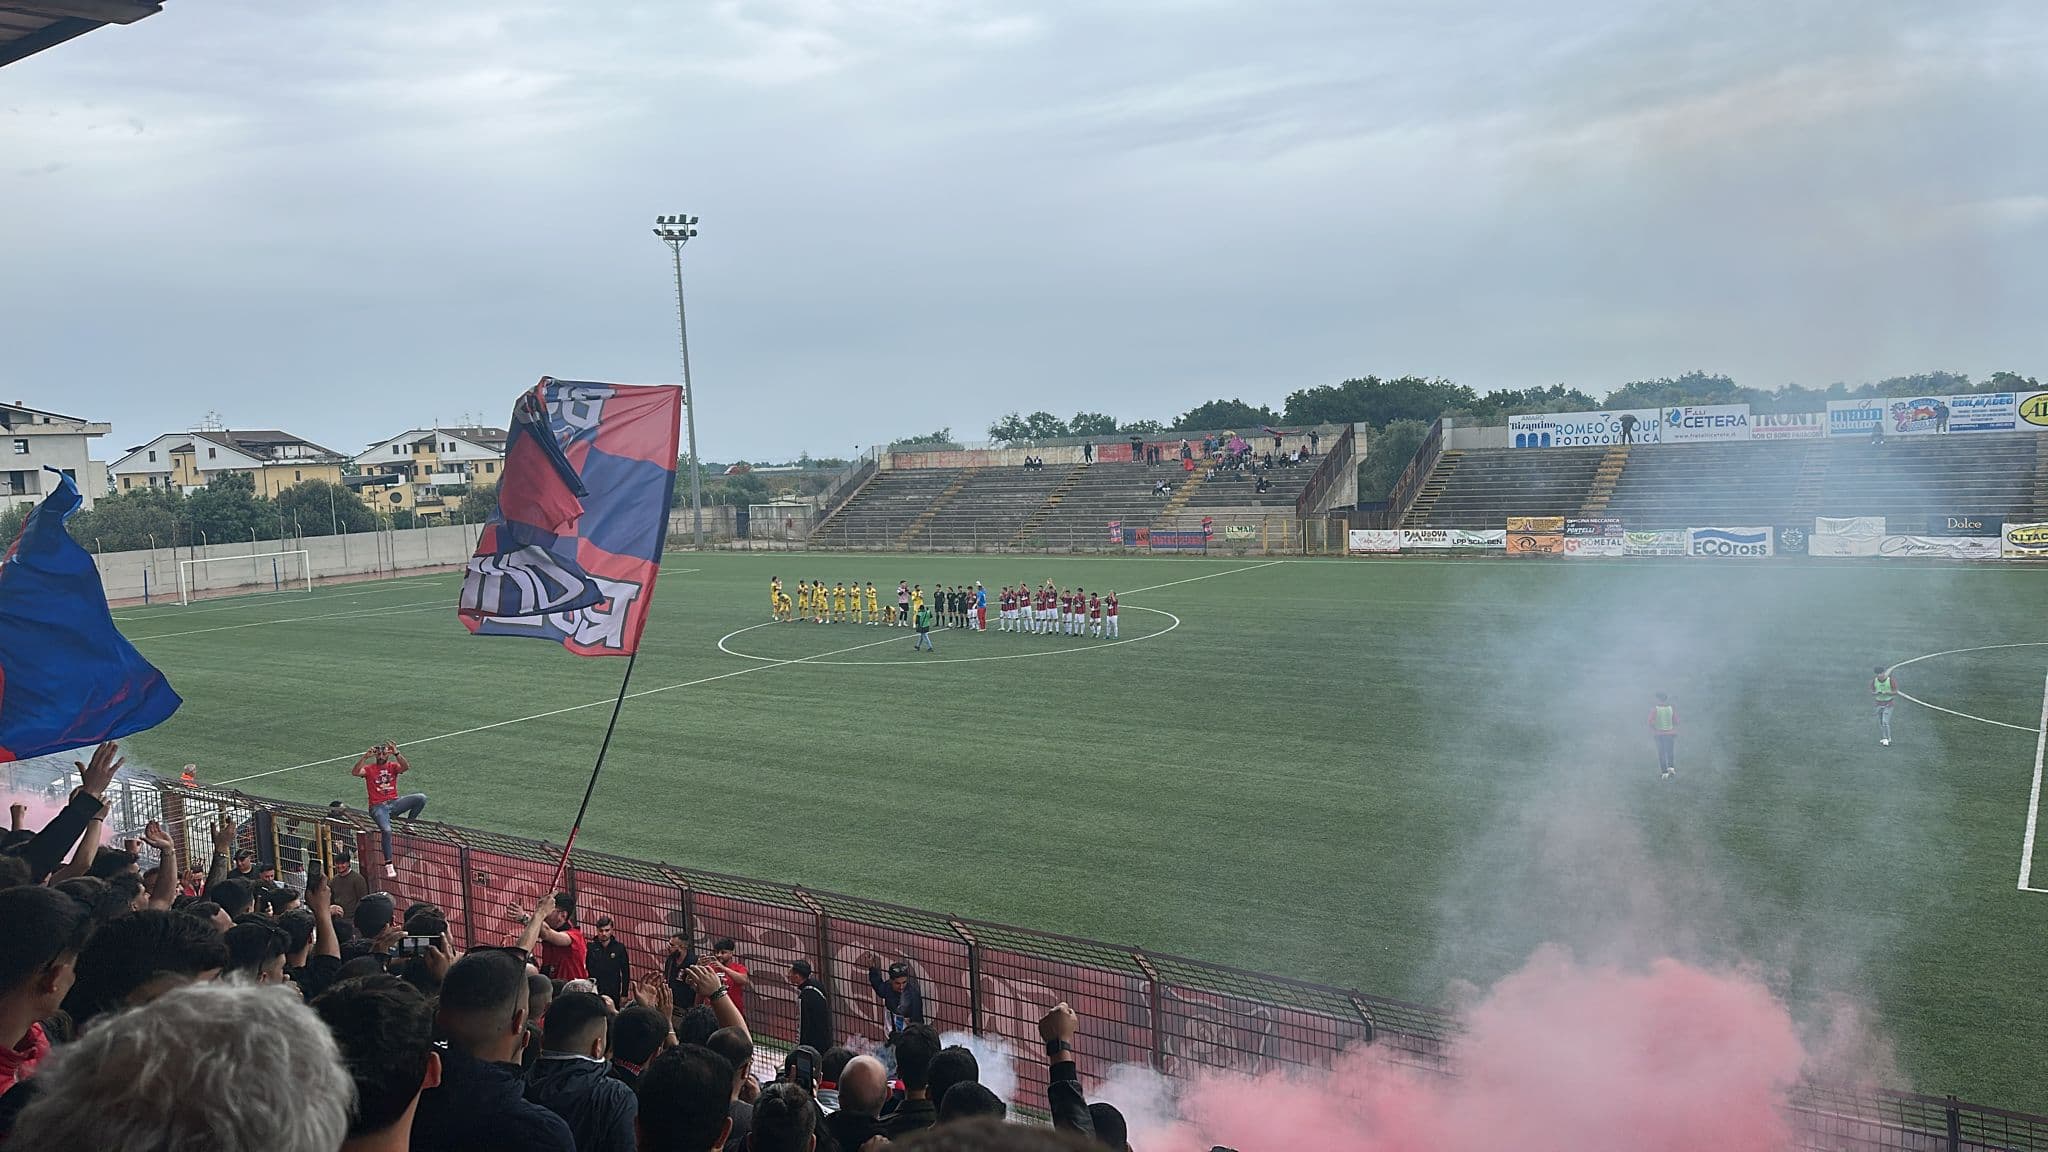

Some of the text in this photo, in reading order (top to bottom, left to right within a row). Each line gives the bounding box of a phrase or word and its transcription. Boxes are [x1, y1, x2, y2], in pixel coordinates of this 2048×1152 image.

[1556, 419, 1660, 435] ROMEO GOUP
[1683, 414, 1748, 428] CETERA
[1556, 433, 1660, 446] FOTOVOLICA
[1947, 517, 1982, 529] Dolce
[1693, 539, 1767, 555] ECOross
